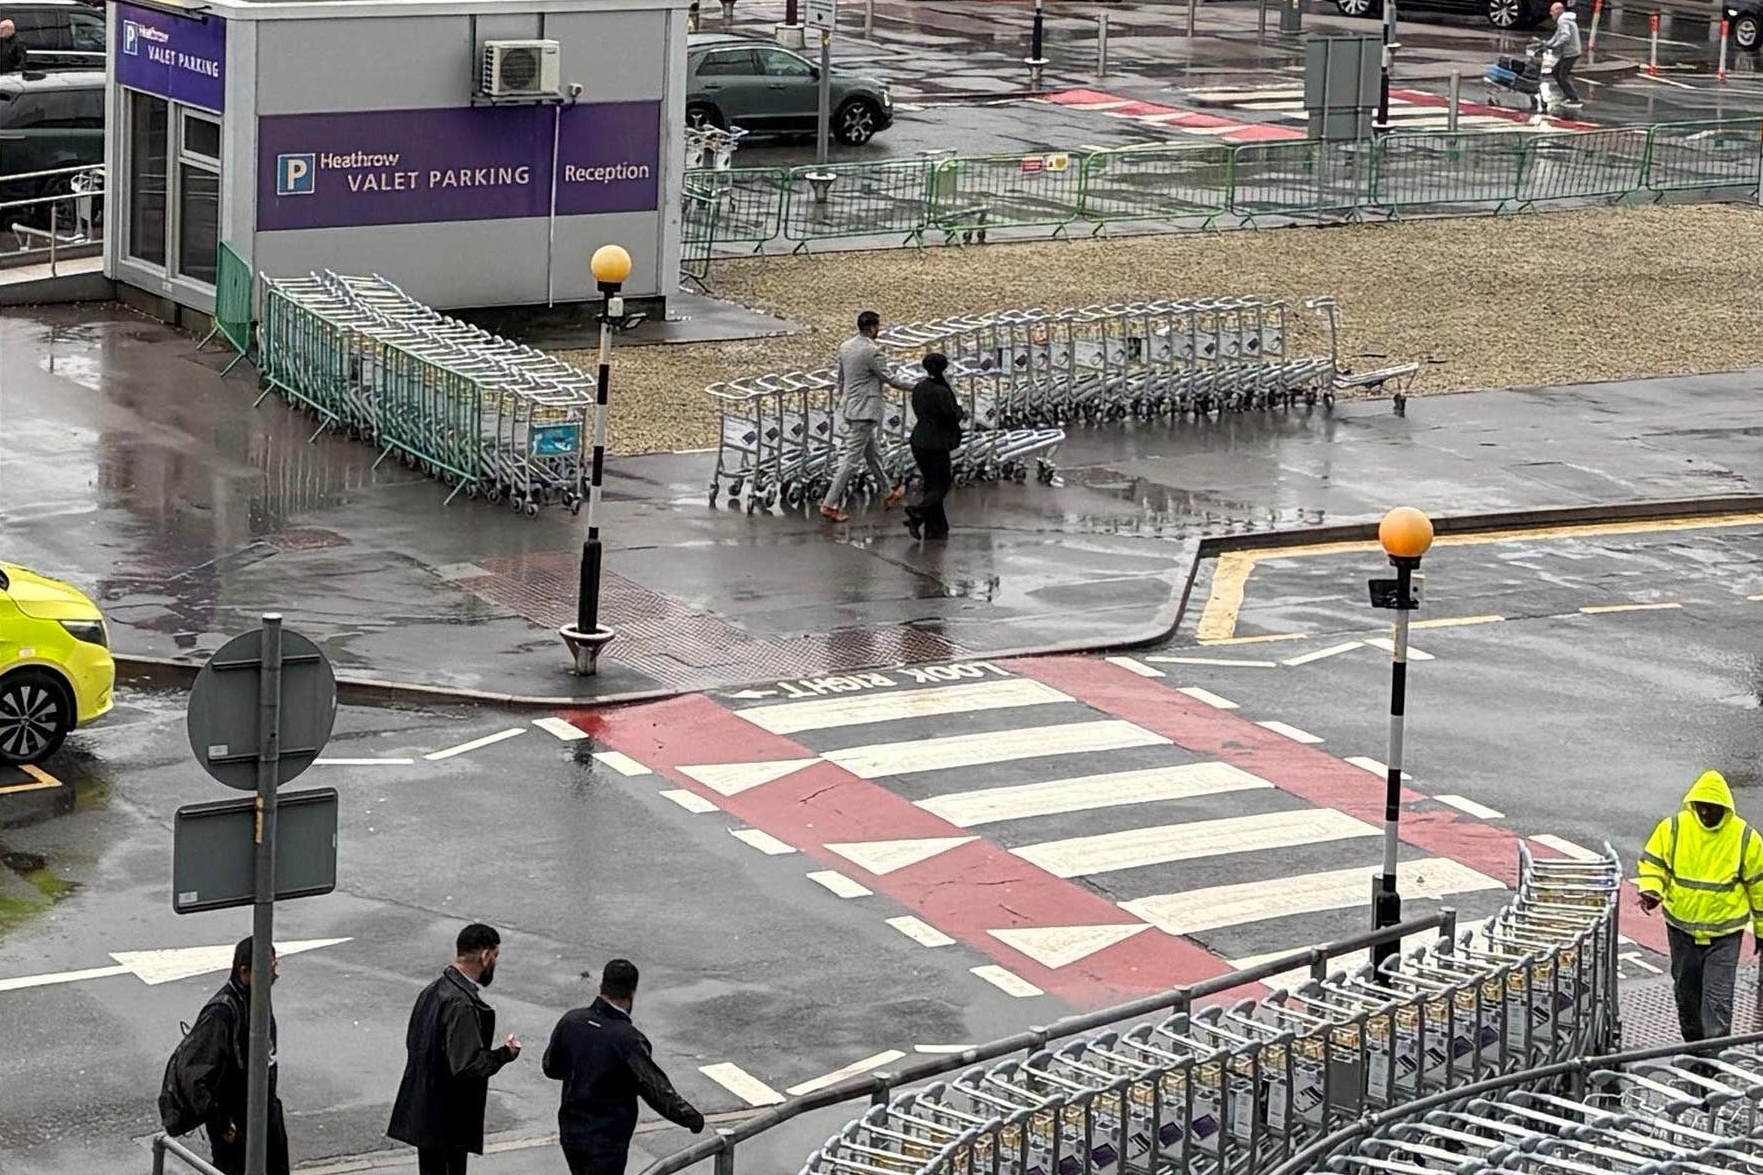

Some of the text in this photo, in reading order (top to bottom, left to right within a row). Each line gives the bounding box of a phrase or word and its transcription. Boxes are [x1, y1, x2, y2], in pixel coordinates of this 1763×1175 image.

[147, 44, 220, 79] VALET PARKING
[320, 151, 400, 169] Heathrow
[565, 162, 649, 185] Reception
[347, 166, 530, 193] VALET PARKING
[777, 660, 1010, 699] LOOK RIGHT
